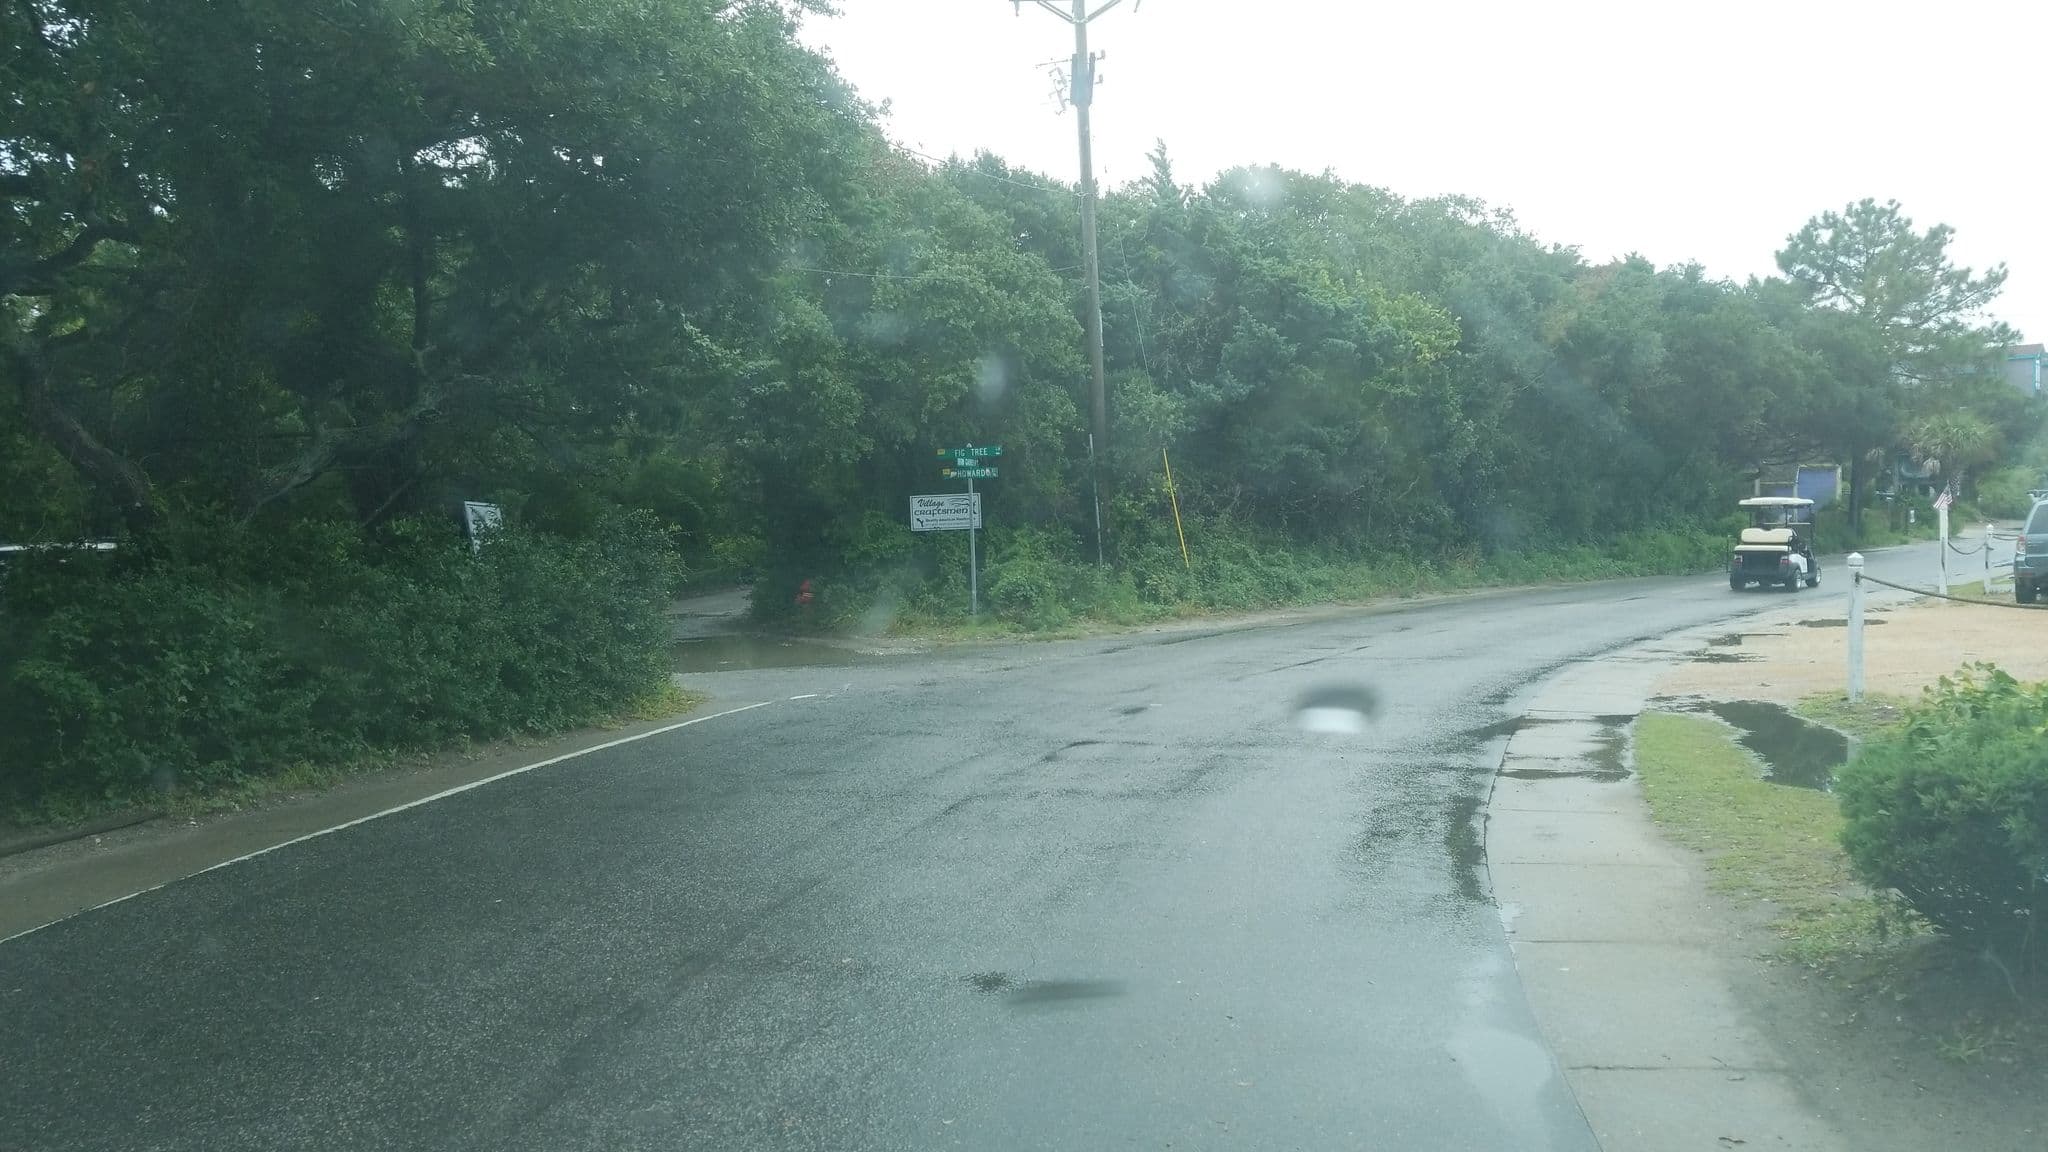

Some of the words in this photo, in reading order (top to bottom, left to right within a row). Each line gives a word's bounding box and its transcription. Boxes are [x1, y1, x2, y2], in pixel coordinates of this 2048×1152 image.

[954, 449, 966, 457] FIG
[970, 447, 988, 456] TREE
[957, 469, 986, 478] HOWARD
[917, 498, 945, 509] Village
